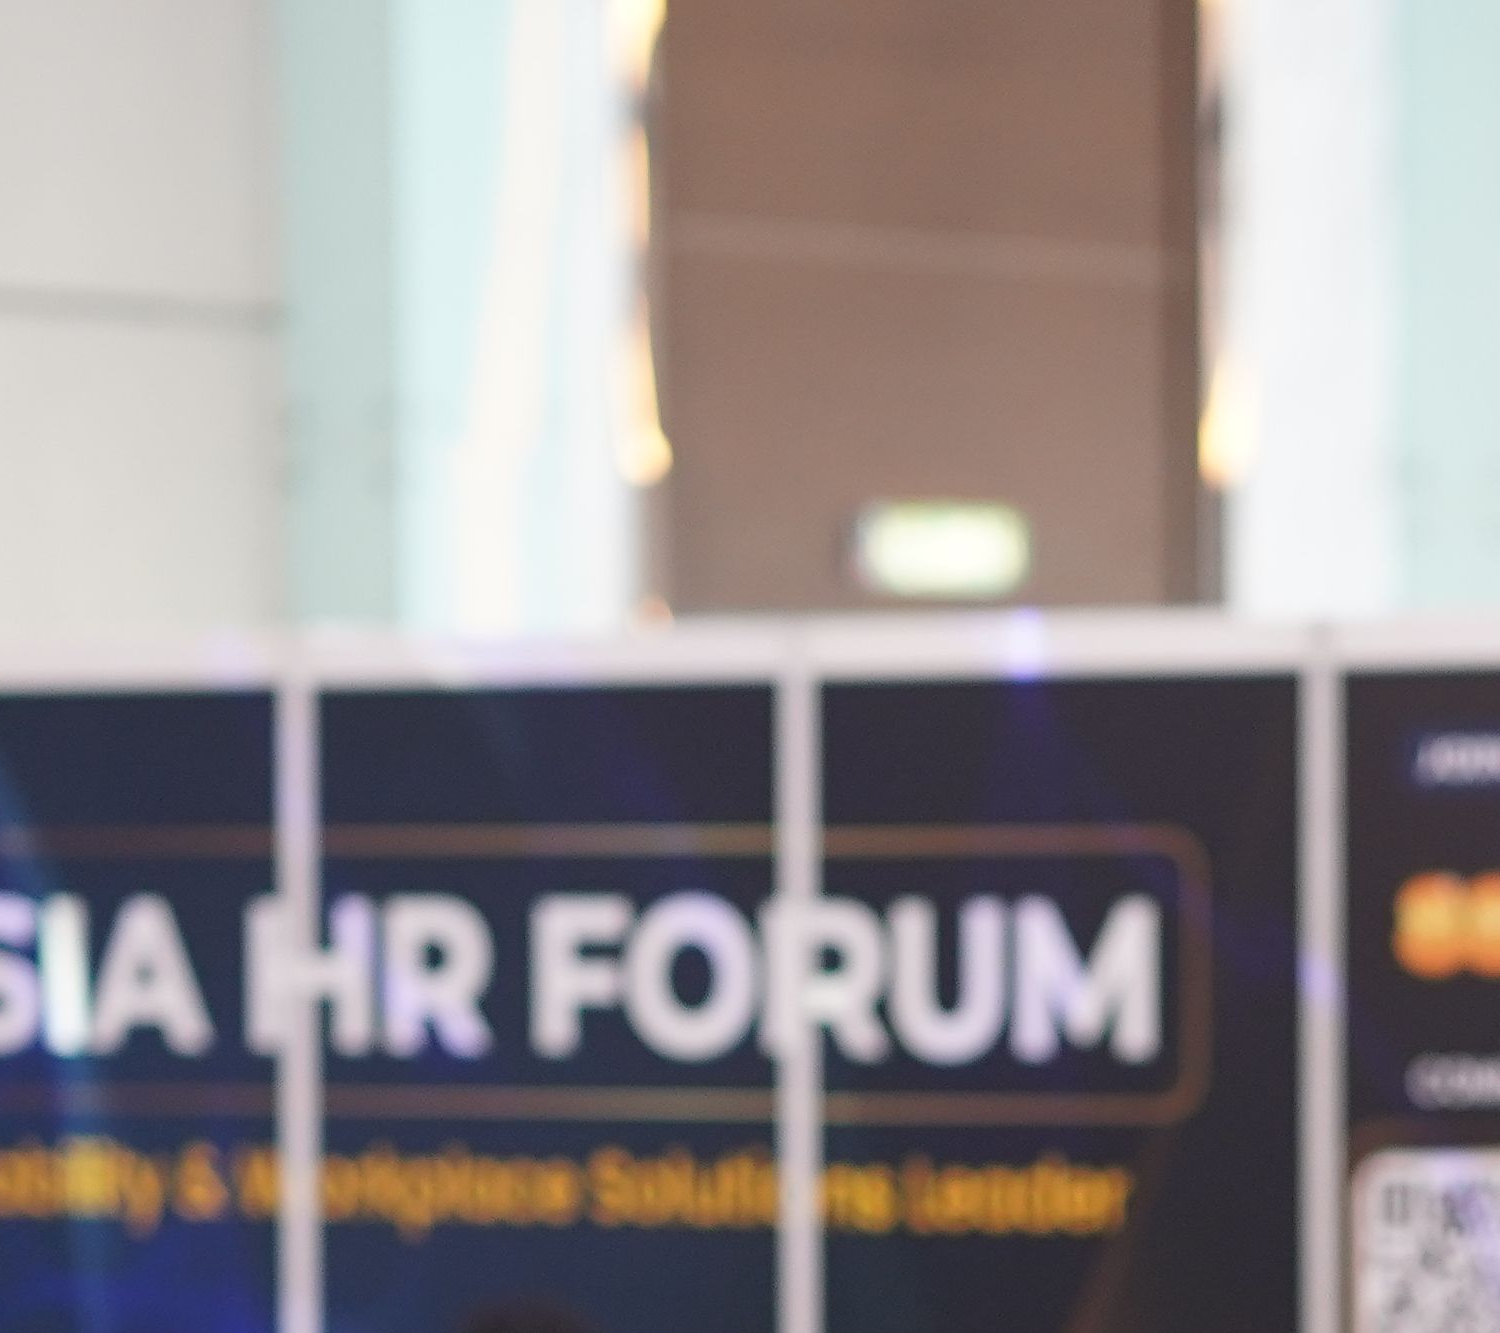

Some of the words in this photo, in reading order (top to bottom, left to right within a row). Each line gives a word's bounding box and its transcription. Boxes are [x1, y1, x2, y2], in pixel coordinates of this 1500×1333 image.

[245, 892, 495, 1060] HR
[528, 889, 1164, 1066] FORUM
[587, 1144, 897, 1233] Solutins
[902, 1150, 1136, 1239] Leader
